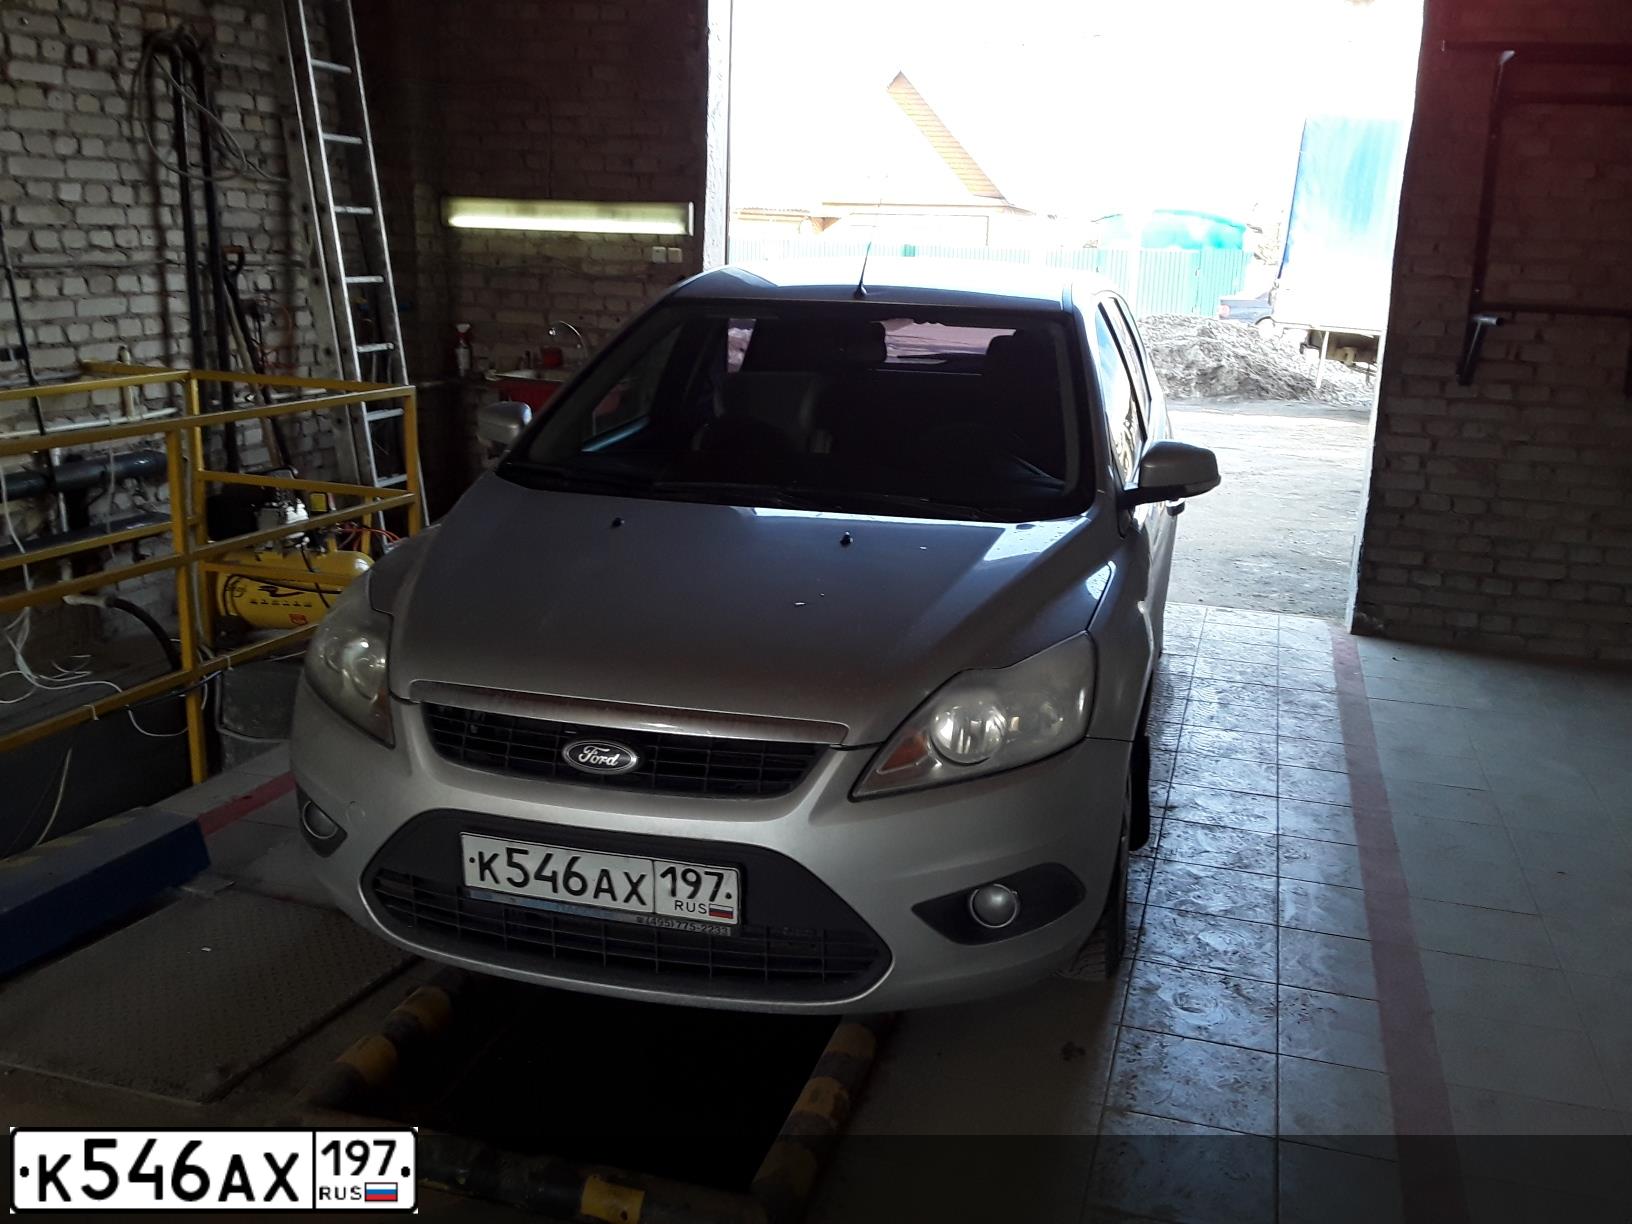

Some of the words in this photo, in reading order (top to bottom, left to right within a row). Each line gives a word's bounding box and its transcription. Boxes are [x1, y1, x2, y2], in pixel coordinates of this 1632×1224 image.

[578, 745, 620, 766] Ford
[660, 866, 725, 903] 197
[674, 900, 707, 915] RUS
